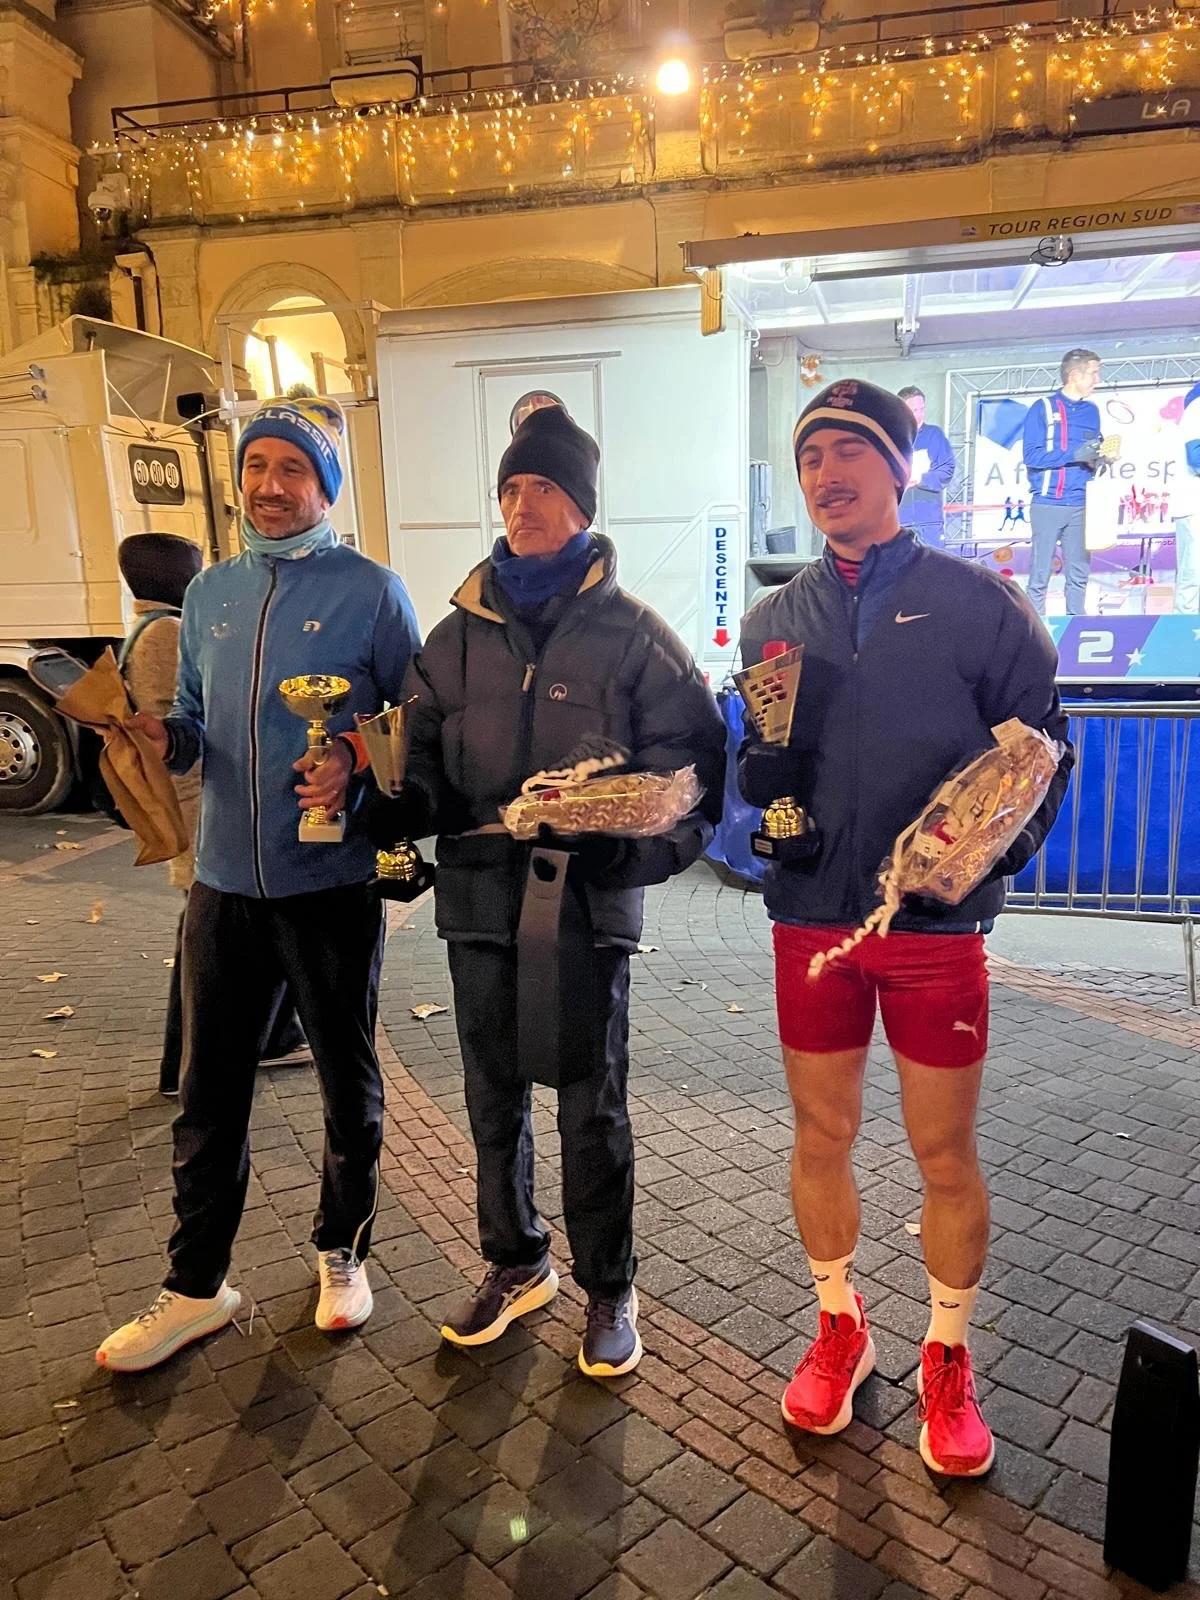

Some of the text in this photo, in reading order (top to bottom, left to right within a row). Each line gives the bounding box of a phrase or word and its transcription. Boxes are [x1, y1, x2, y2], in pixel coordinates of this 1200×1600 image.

[989, 220, 1041, 236] TOUR
[1047, 211, 1126, 230] REGION
[1132, 207, 1172, 223] SUD
[136, 462, 177, 486] 60 80 90
[984, 462, 1004, 486] A
[715, 527, 728, 627] DESCENTE
[1078, 630, 1114, 664] 2
